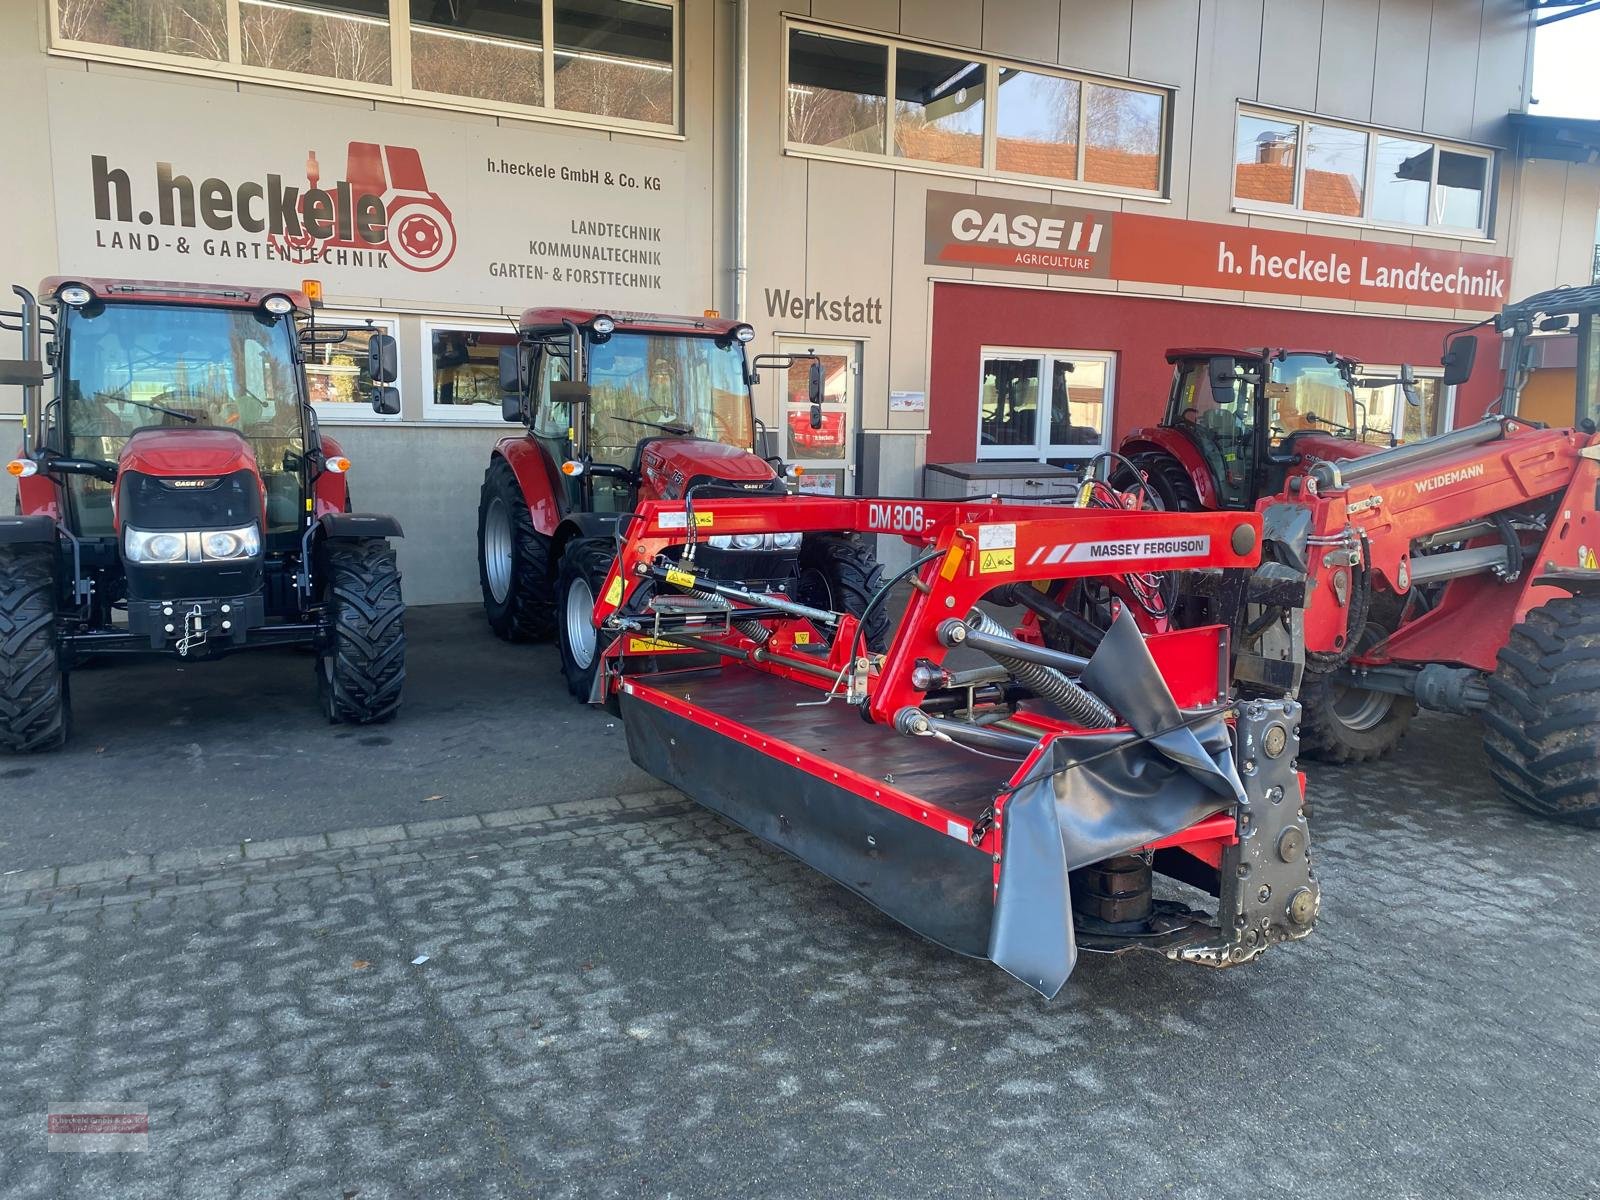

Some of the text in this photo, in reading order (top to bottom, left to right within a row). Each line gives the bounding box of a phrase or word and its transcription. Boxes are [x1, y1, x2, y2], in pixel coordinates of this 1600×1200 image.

[487, 158, 661, 191] h.heckele GmbH & Co. KG
[91, 154, 387, 244] h.heckele
[571, 219, 661, 242] LANDTECHNIK
[951, 208, 1066, 249] CASE
[203, 238, 389, 269] GARTENTECHNIK
[529, 240, 661, 266] KOMMUNALTECHNIK
[1014, 252, 1090, 270] AGRICULTURE
[489, 262, 661, 289] GARTEN- & FORSTTECHNIK
[1217, 241, 1505, 298] h. heckele Landtechnik
[764, 287, 882, 325] Werkstatt
[1414, 463, 1484, 494] WEIDEMANN
[869, 503, 892, 529] DM
[893, 505, 924, 532] 306
[1090, 540, 1204, 557] MASSEY FERGUSON
